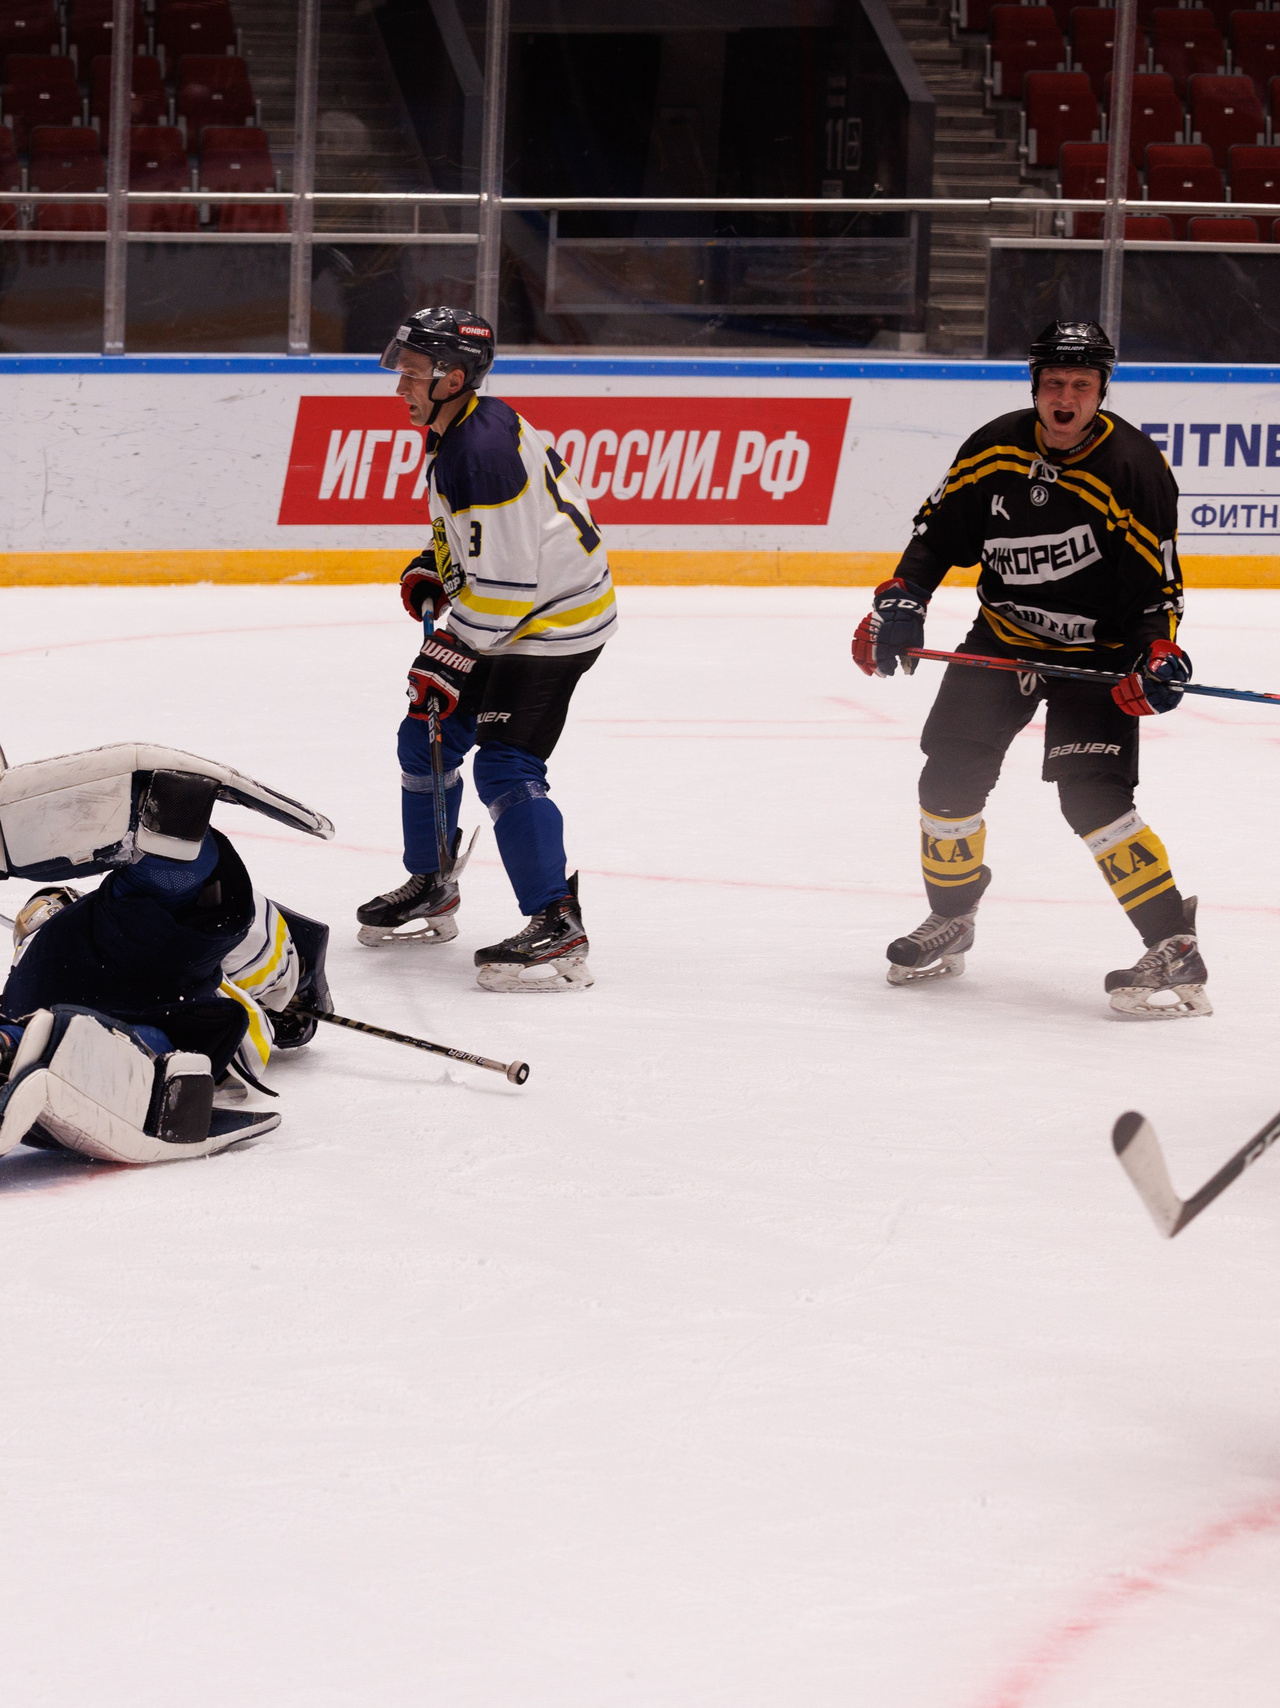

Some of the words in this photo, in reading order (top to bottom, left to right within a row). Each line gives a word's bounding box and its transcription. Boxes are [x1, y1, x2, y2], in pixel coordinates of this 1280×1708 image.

[460, 326, 490, 337] FONBET
[318, 429, 427, 500] ИГР
[535, 429, 811, 501] ОССИИ.РФ
[1191, 503, 1279, 528] ФИТН
[476, 711, 512, 724] UER
[1048, 742, 1122, 760] BAUER
